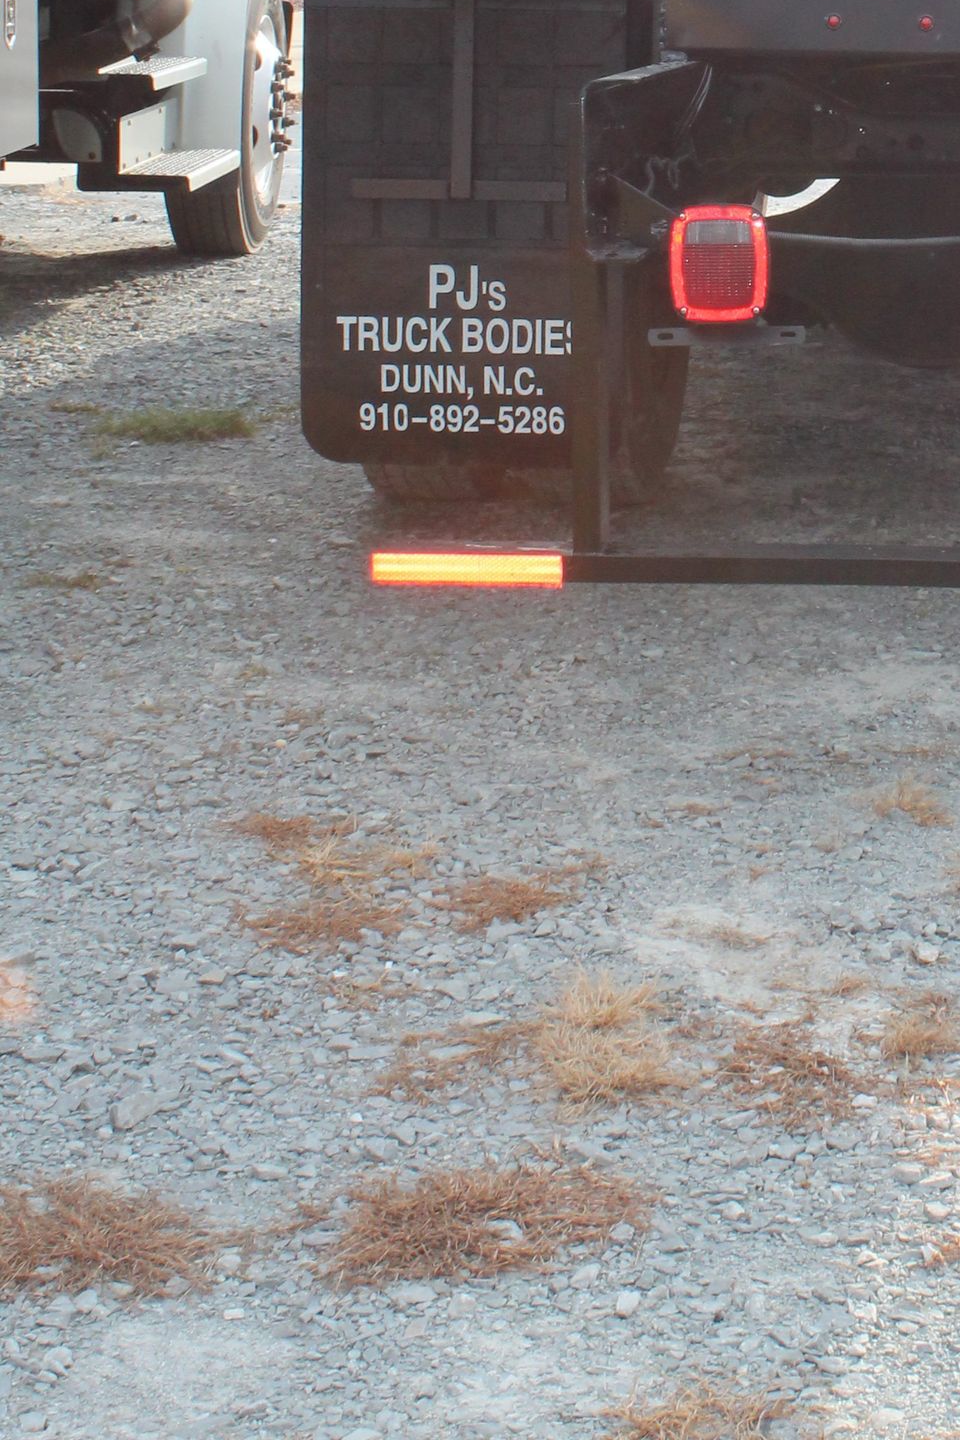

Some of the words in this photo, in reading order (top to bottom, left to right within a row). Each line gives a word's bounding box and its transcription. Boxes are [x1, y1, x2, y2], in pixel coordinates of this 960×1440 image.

[428, 263, 506, 311] PJ's
[336, 315, 452, 353] TRUCK
[462, 317, 572, 355] BODIE
[380, 364, 474, 400] DUNN,
[483, 365, 544, 396] N.C.
[359, 403, 565, 435] 910-892-5286
